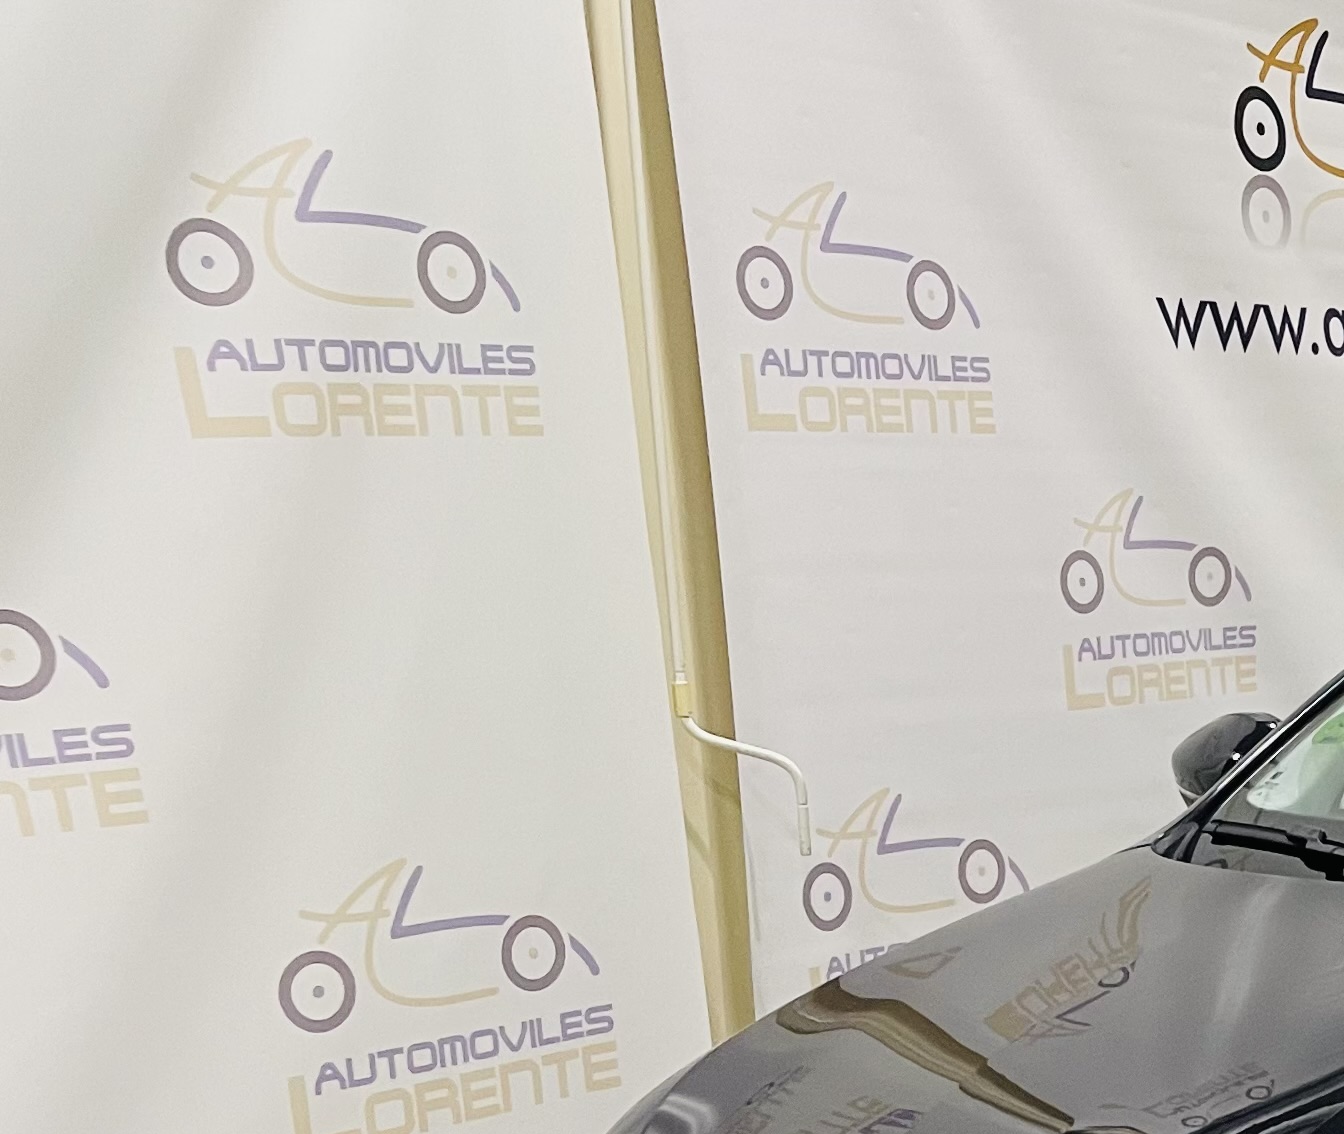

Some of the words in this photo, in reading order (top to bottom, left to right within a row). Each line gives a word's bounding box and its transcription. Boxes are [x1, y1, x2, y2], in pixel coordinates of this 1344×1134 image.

[206, 339, 536, 376] AUTOMOVILES
[760, 348, 991, 383] AUTOMOVILES
[174, 347, 544, 439] LORENTE
[740, 354, 997, 434] LORENTE
[1078, 625, 1257, 661] AUTOMOVILES
[1062, 645, 1257, 711] LORENTE
[314, 1004, 614, 1096] AUTOMOVILES
